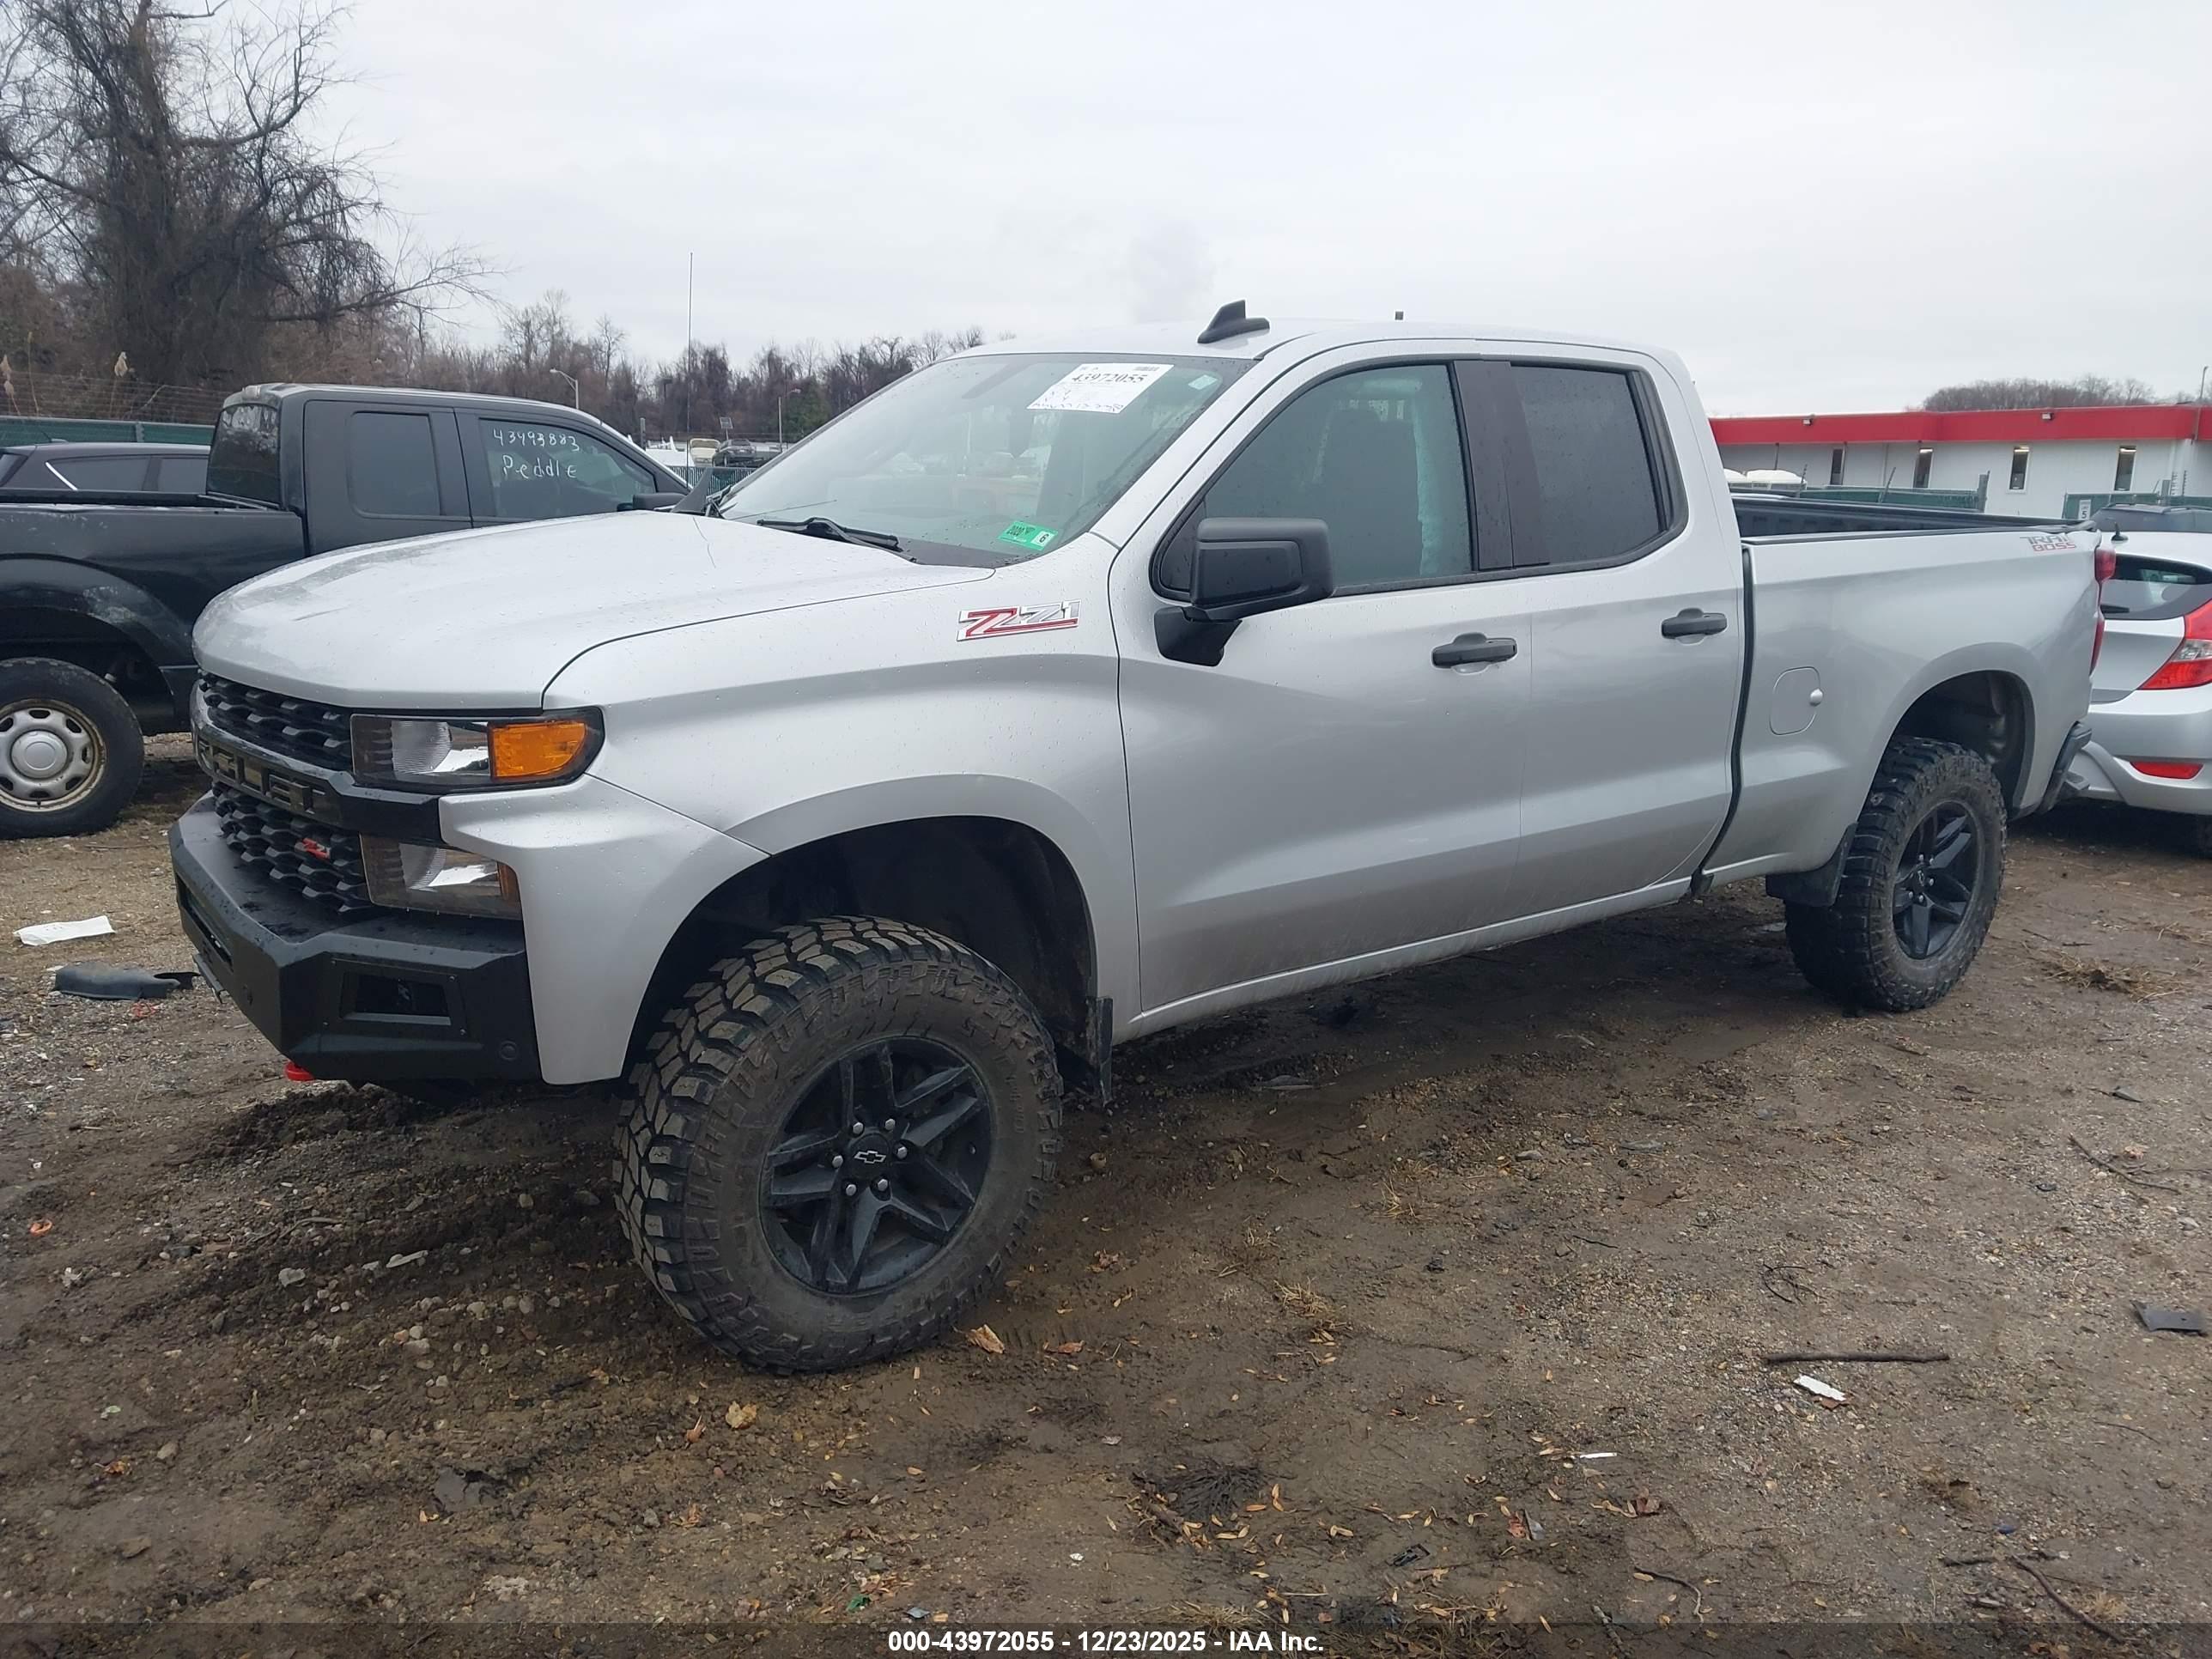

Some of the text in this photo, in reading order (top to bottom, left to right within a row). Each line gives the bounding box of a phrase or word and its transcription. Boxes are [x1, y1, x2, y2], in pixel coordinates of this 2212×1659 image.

[1071, 373, 1148, 383] 43972055
[2081, 510, 2087, 519] 5
[1039, 533, 1049, 544] 6
[2032, 542, 2076, 552] BOSS
[957, 599, 1081, 641] Z71
